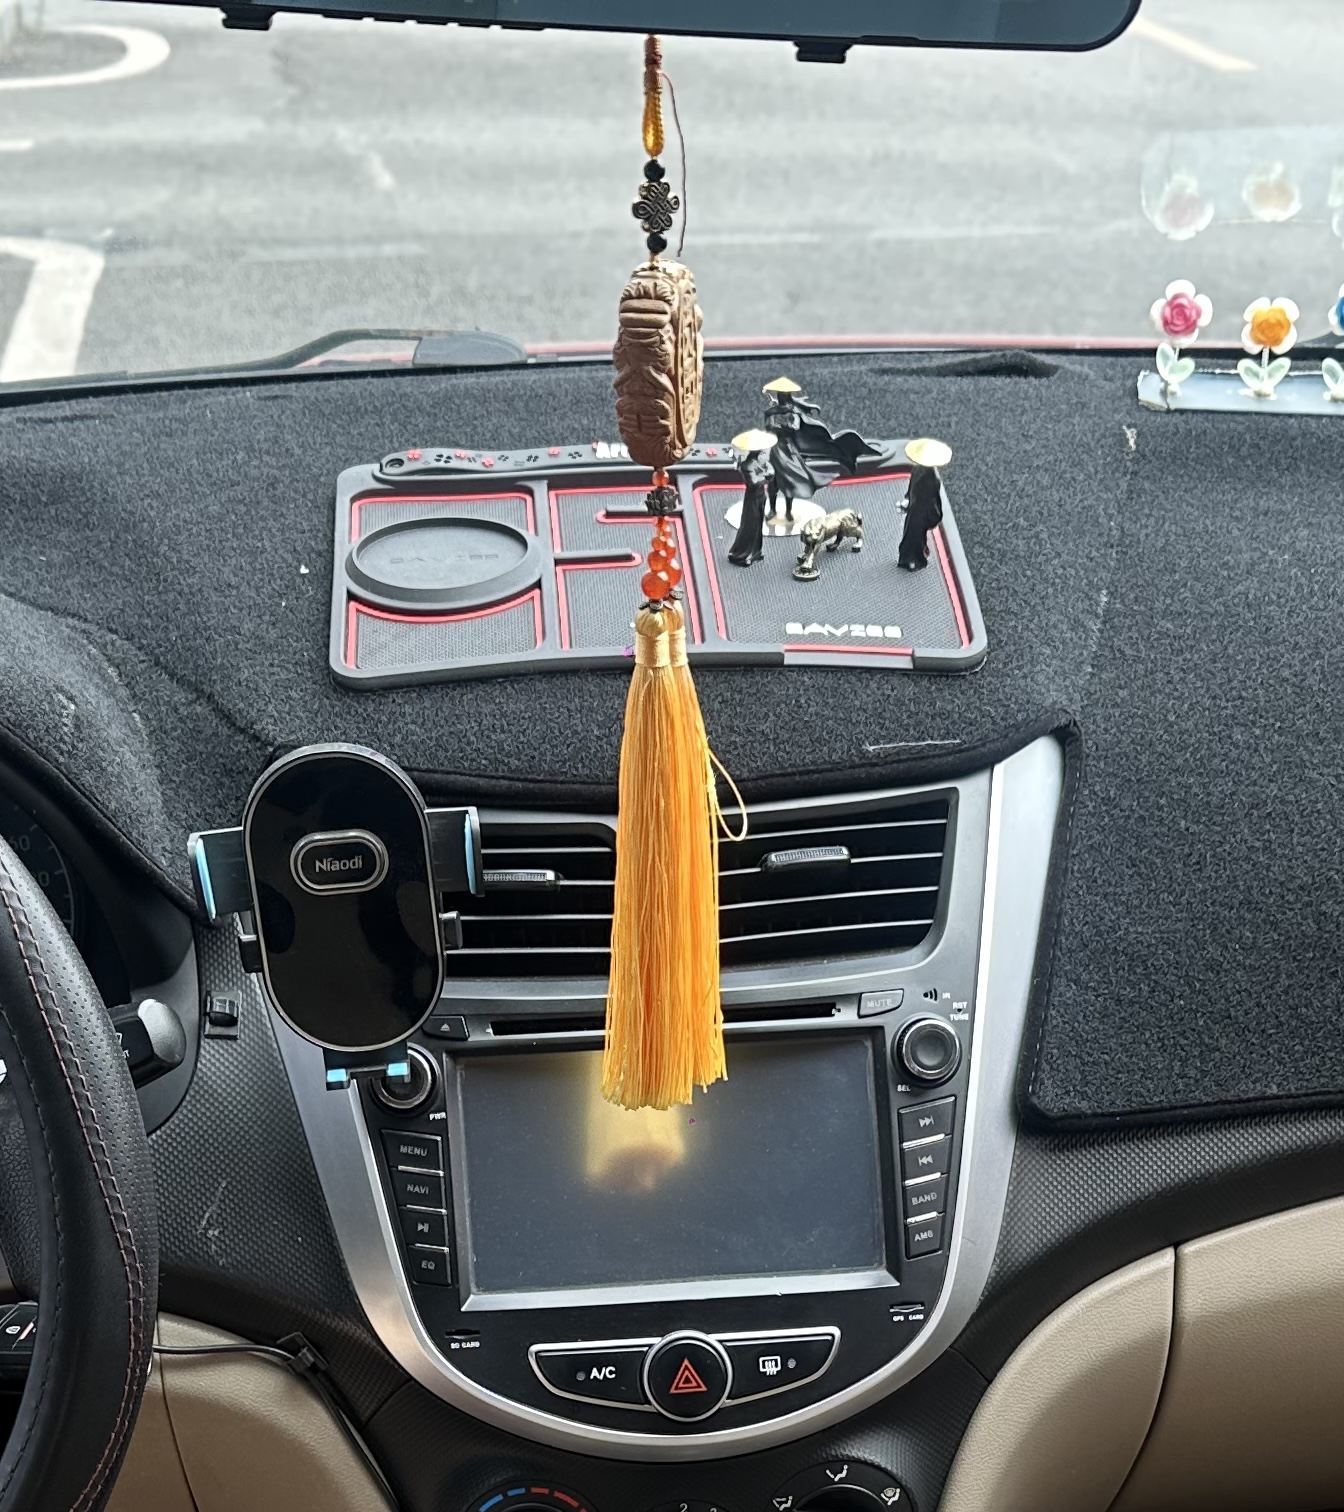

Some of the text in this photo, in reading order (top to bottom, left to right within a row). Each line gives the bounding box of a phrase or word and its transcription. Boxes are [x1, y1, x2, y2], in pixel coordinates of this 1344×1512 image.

[866, 998, 894, 1009] MUTE
[399, 1144, 429, 1158] MENU
[406, 1183, 430, 1196] NAVI
[911, 1191, 938, 1206] BAND
[421, 1259, 436, 1271] EQ
[589, 1365, 616, 1380] A/C
